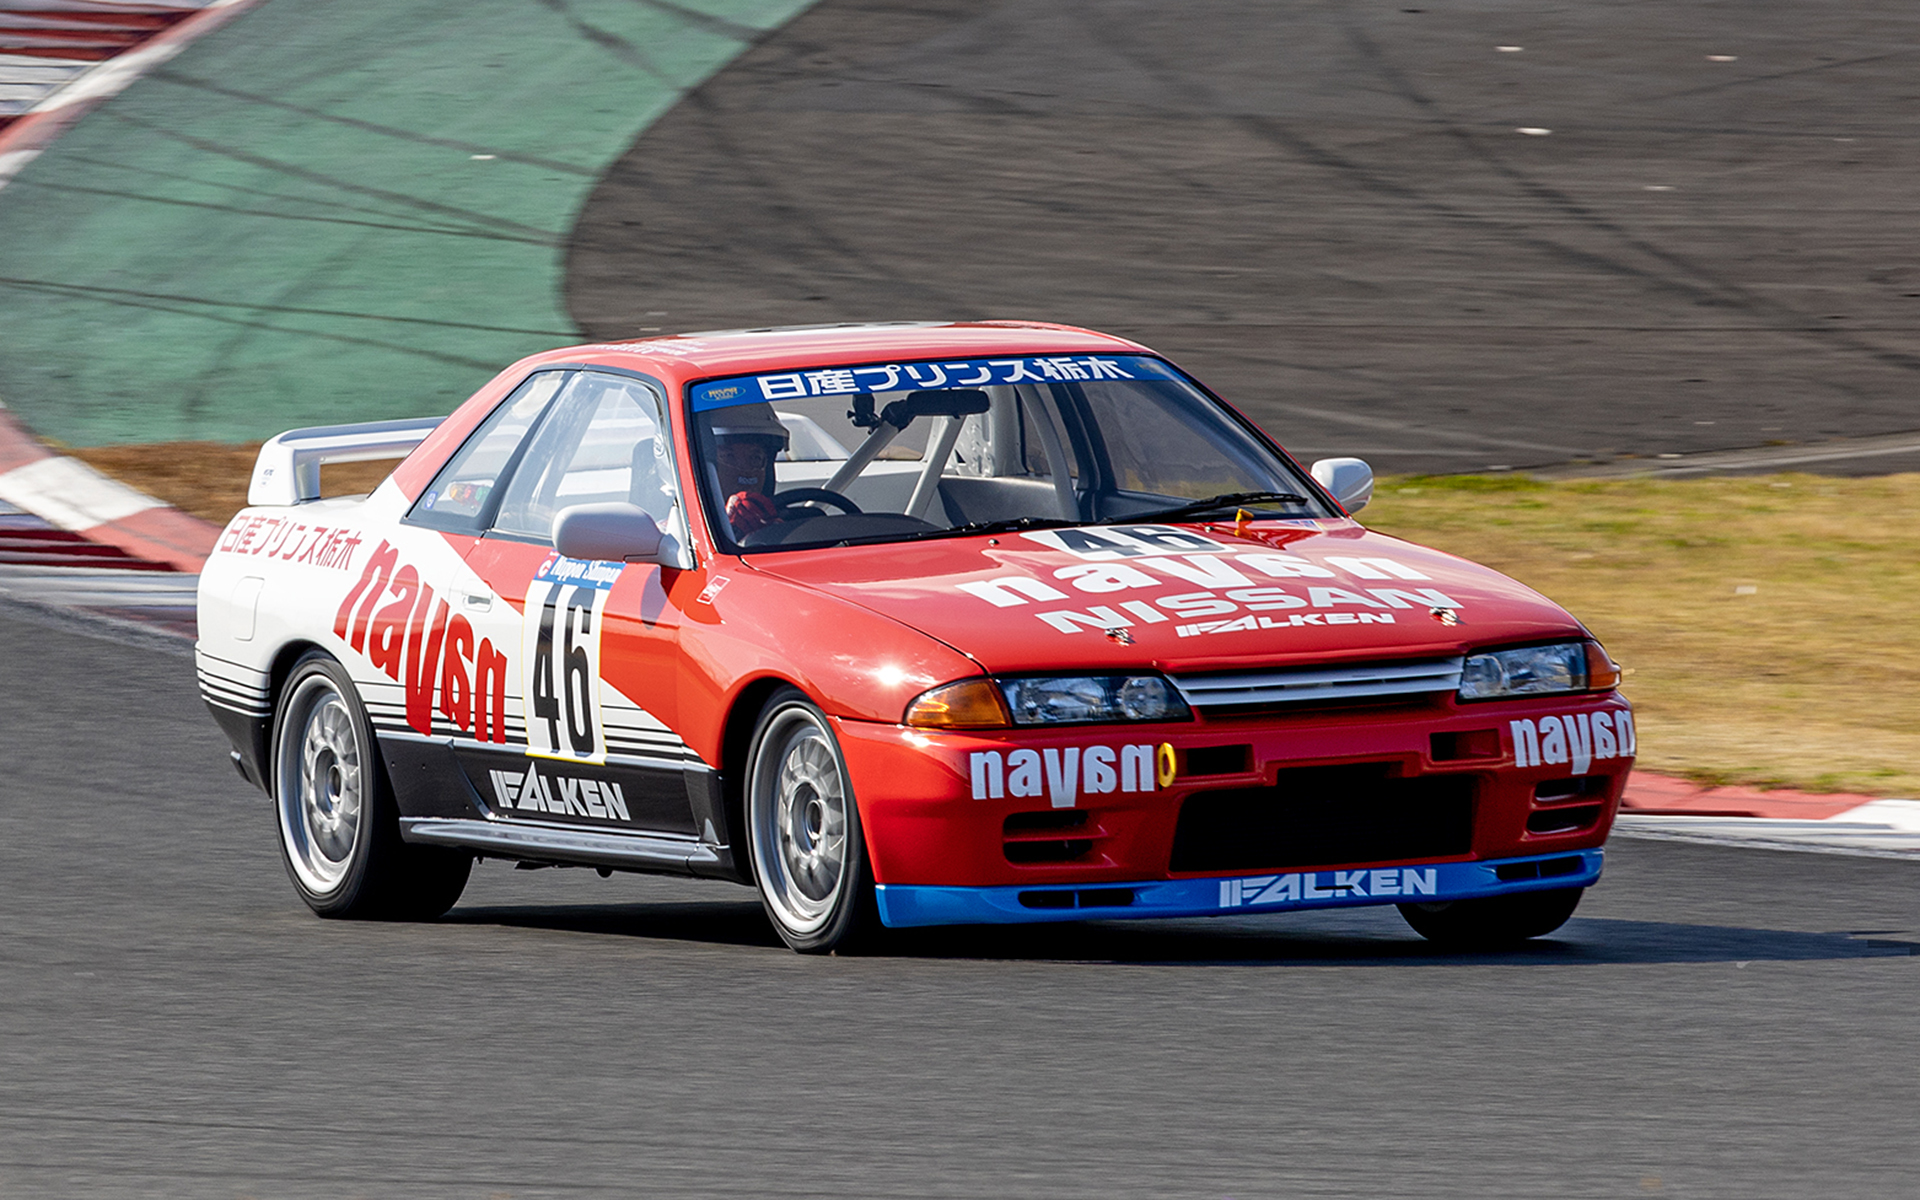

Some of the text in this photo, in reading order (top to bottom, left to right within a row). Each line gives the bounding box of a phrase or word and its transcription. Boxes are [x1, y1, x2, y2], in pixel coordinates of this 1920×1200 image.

[756, 356, 1135, 400] 日産プリンス栃木
[219, 514, 363, 571] 日産プリンス栃木
[1048, 523, 1216, 556] 46
[1034, 586, 1465, 635] NISSAN
[1174, 612, 1396, 638] FALKEN
[532, 583, 596, 758] 46
[488, 760, 632, 822] FALKEN
[1218, 868, 1438, 909] FALKEN
